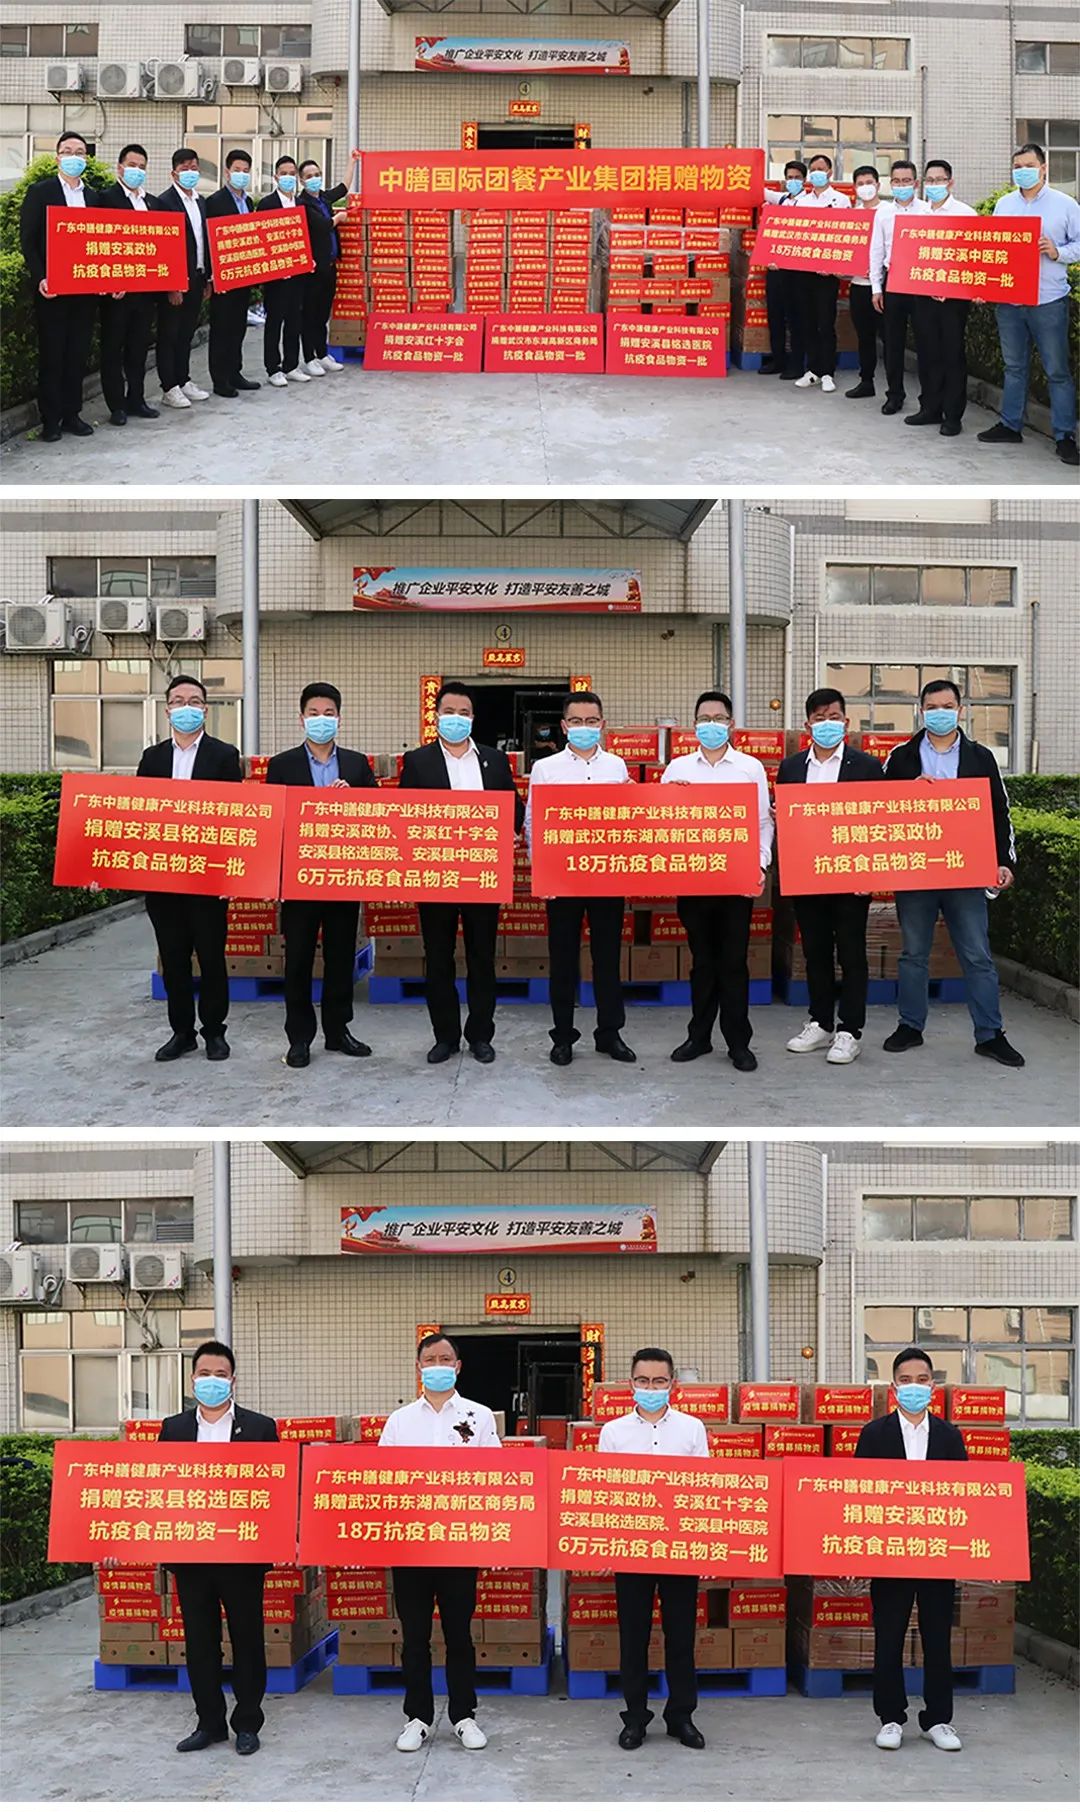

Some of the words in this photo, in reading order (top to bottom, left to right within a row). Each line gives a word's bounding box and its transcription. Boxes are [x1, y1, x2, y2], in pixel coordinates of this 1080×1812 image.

[446, 48, 523, 63] 推广企业平安文化
[528, 48, 607, 63] 打造平安友善之城
[379, 164, 751, 192] 中膳国际团餐产业集团捐赠物资
[57, 222, 179, 236] 广东中膳健康产业科技有限公司
[900, 228, 1032, 243] 广东中膳健康产业科技有限公司
[86, 241, 156, 256] 捐赠安溪政协
[770, 244, 854, 261] 18万抗疫食品物资
[919, 246, 1008, 264] 捐赠安溪中医院
[73, 264, 169, 279] 抗疫食品物资一批
[910, 265, 1013, 287] 抗疫食品物资一批
[385, 335, 464, 346] 捐赠安溪红十字会
[383, 350, 463, 361] 抗疫食品物资一批
[504, 350, 585, 361] 抗疫食品物资一批
[625, 354, 707, 366] 抗疫食品物资一批
[392, 581, 498, 597] 推广企业平安文化
[505, 581, 611, 597] 打造平安友善之城
[73, 793, 272, 820] 广东中膳健康产业科技有限公司
[300, 801, 499, 819] 广东中膳健康产业科技有限公司
[545, 805, 746, 820] 广东中膳健康产业科技有限公司
[789, 797, 981, 817] 广东中膳健康产业科技有限公司
[85, 818, 257, 847] 捐赠安溪县铭选医院
[543, 827, 749, 844] 捐赠武汉市东湖高新区商务局
[831, 822, 943, 845] 捐赠安溪政协
[92, 849, 245, 877] 抗疫食品物资一批
[567, 853, 727, 873] 18万抗疫食品物资
[814, 850, 964, 874] 抗疫食品物资一批
[298, 868, 498, 888] 6万元抗疫食品物资一批
[384, 1221, 499, 1237] 推广企业平安文化
[506, 1221, 623, 1237] 打造平安友善之城
[67, 1462, 285, 1479] 广东中膳健康产业科技有限公司
[316, 1470, 533, 1486] 广东中膳健康产业科技有限公司
[562, 1466, 768, 1490] 广东中膳健康产业科技有限公司
[798, 1477, 1012, 1497] 广东中膳健康产业科技有限公司
[80, 1488, 270, 1509] 捐赠安溪县铭选医院
[314, 1493, 535, 1511] 捐赠武汉市东湖高新区商务局
[843, 1504, 968, 1527] 捐赠安溪政协
[89, 1520, 258, 1541] 抗疫食品物资一批
[338, 1521, 511, 1542] 18万抗疫食品物资
[558, 1536, 768, 1562] 6万元抗疫食品物资一批
[822, 1534, 991, 1558] 抗疫食品物资一批
